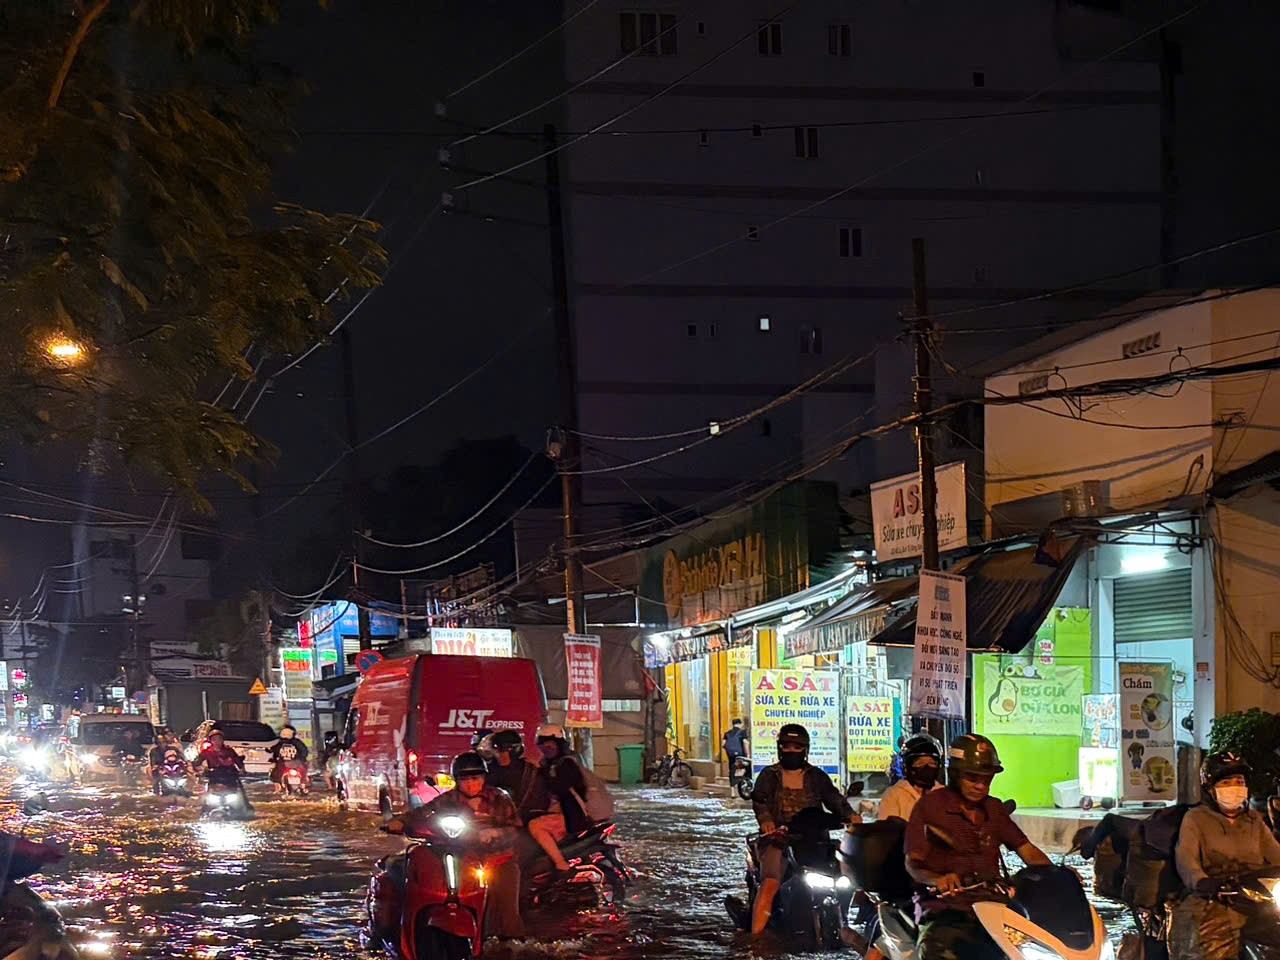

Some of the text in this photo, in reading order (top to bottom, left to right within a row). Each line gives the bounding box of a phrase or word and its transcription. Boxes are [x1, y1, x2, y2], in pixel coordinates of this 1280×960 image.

[896, 529, 904, 539] xe
[756, 676, 776, 690] A
[755, 692, 775, 705] SỬA
[778, 696, 790, 705] XE
[800, 693, 820, 706] RỬA
[823, 697, 835, 706] XE
[439, 709, 525, 729] J&T EXPRESS
[849, 712, 891, 727] RỬA XE
